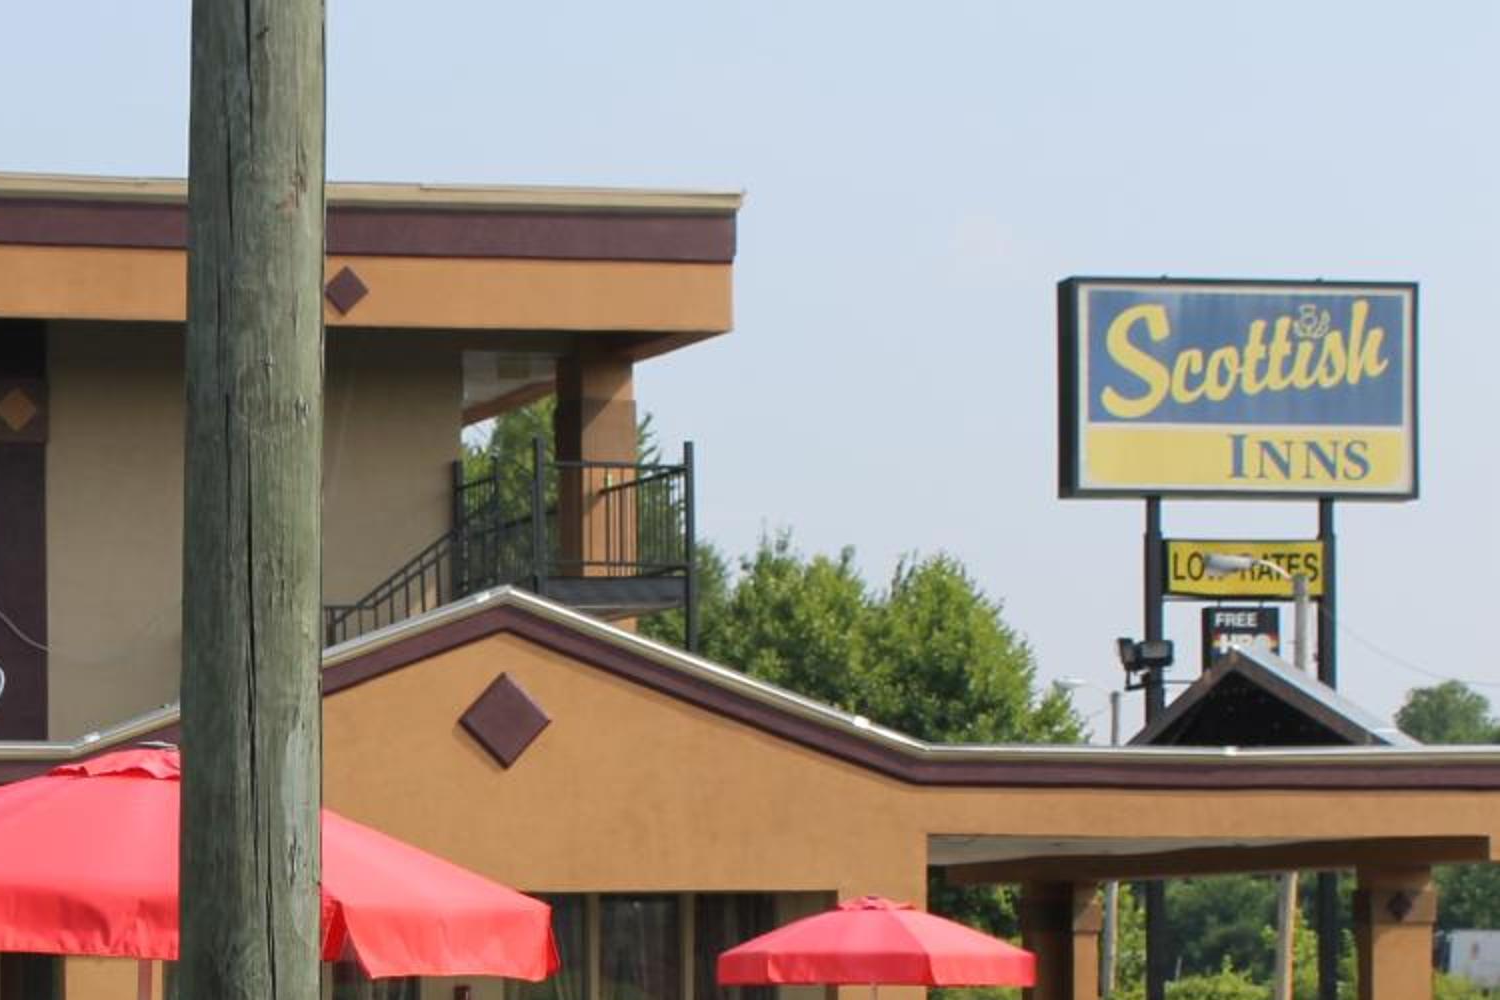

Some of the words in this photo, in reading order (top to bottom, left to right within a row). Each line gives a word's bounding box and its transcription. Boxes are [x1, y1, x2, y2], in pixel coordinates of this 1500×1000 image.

[1101, 299, 1388, 418] Scottish
[1227, 433, 1371, 482] INNS
[1173, 551, 1225, 581] LO
[1214, 611, 1258, 627] FREE
